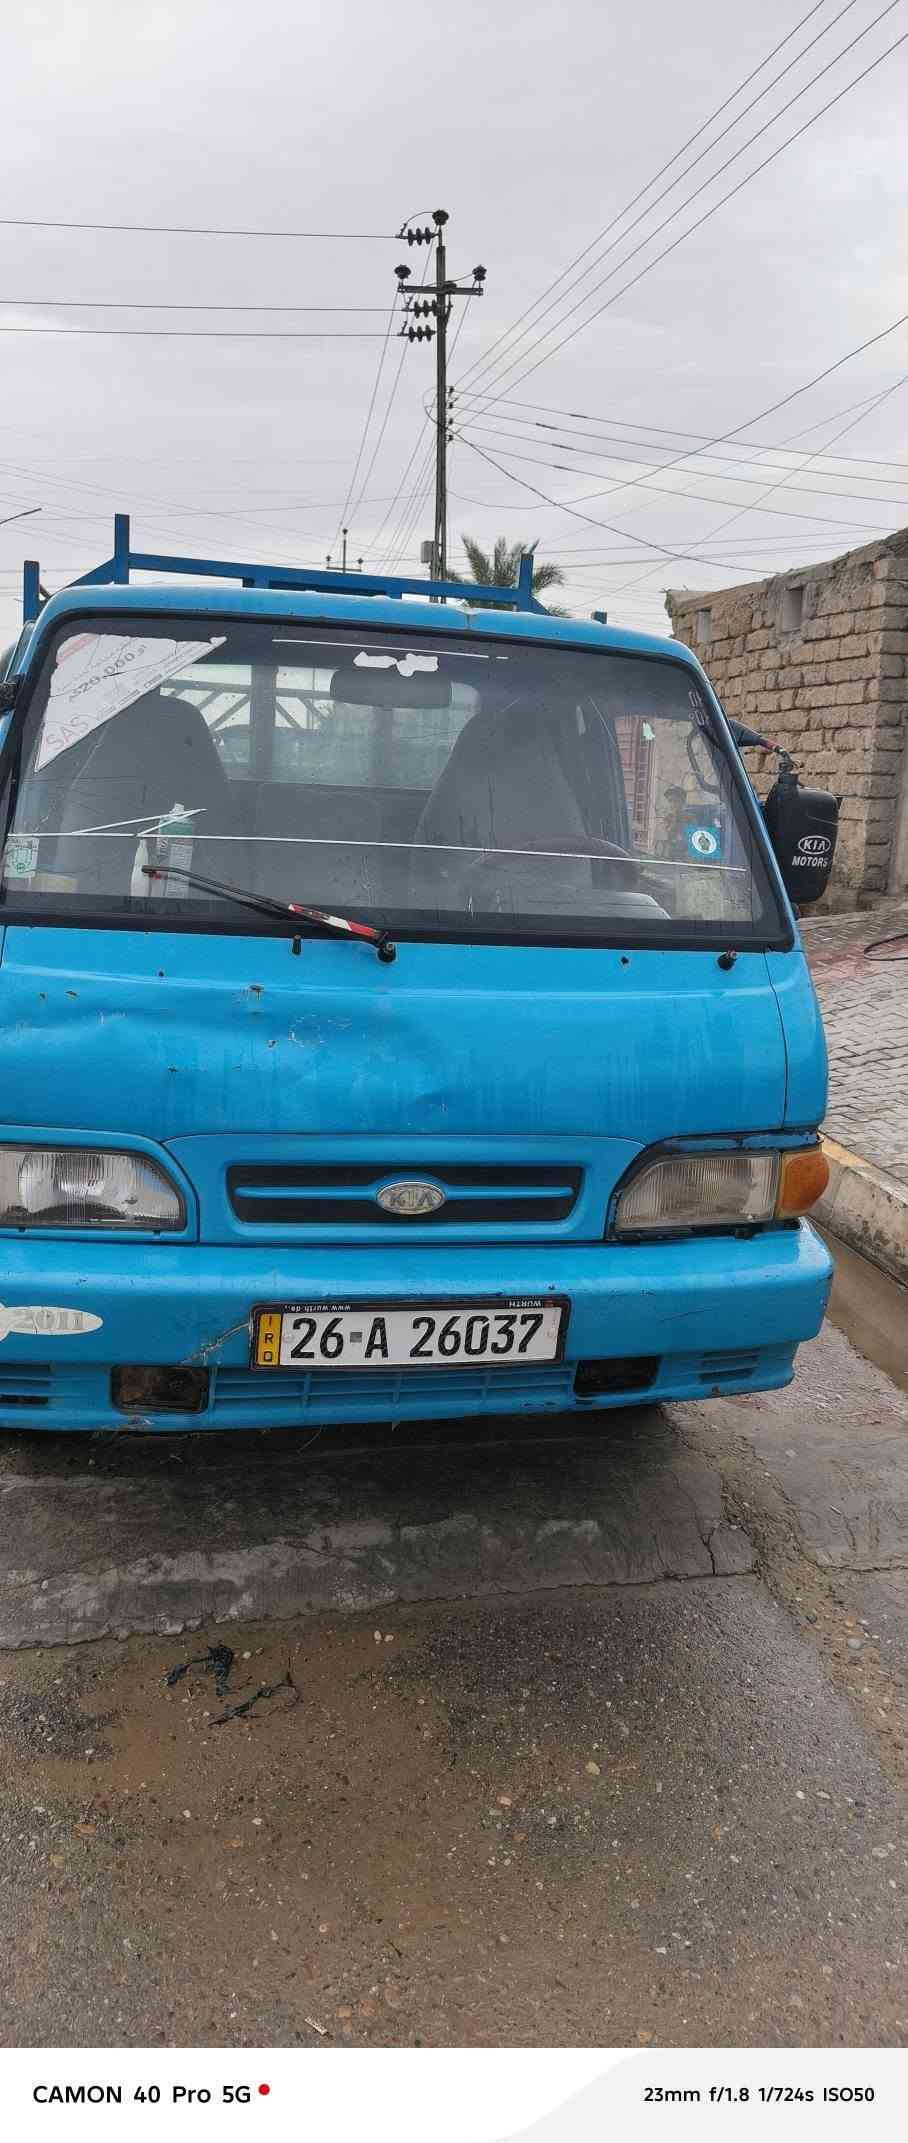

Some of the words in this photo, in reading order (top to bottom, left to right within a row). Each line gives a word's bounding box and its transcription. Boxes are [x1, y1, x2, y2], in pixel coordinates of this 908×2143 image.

[803, 839, 826, 850] KIA
[792, 856, 829, 868] MOTORS
[389, 1188, 433, 1207] KIA
[290, 1317, 344, 1359] 26
[364, 1316, 389, 1359] A
[409, 1313, 544, 1357] 26037
